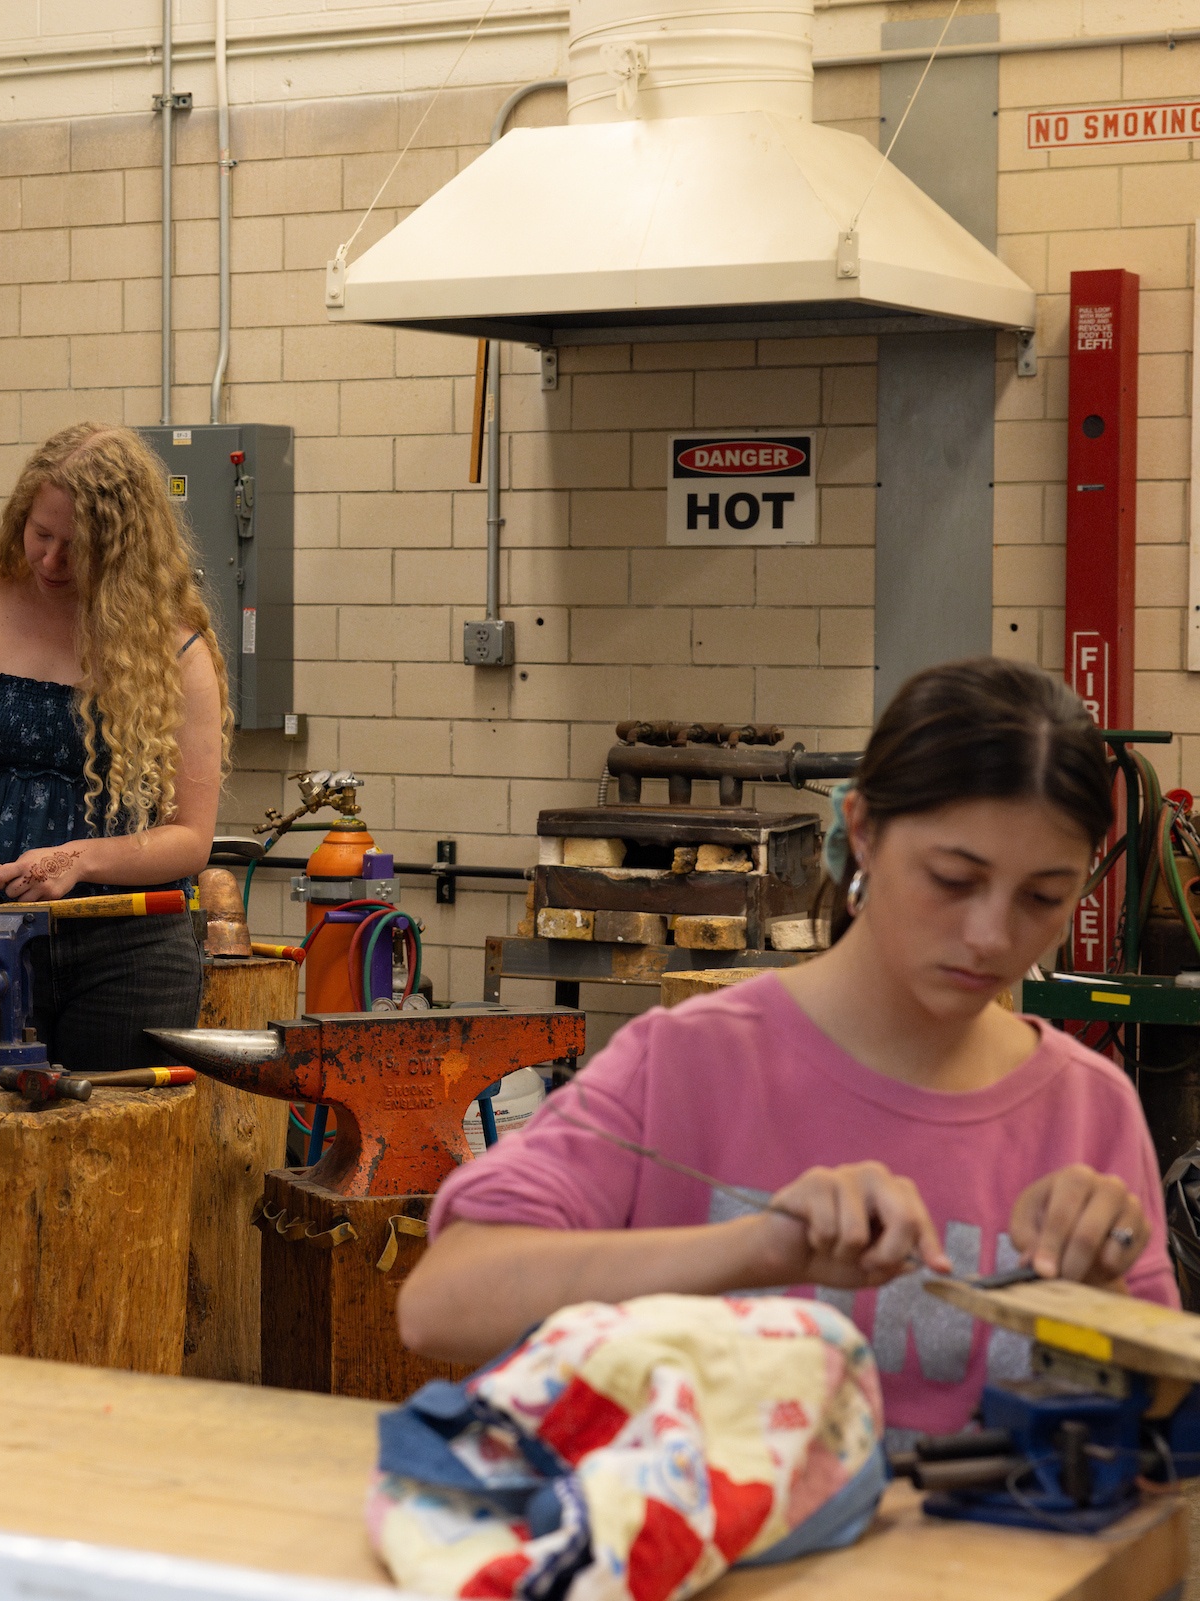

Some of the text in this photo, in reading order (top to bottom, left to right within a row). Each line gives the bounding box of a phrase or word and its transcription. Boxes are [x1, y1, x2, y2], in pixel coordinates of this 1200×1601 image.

[1035, 117, 1069, 143] NO
[1078, 324, 1112, 332] REVOLVE
[1102, 331, 1113, 339] TO
[1078, 338, 1112, 350] LEFT!
[694, 449, 789, 467] DANGER
[687, 492, 795, 530] HOT
[1080, 647, 1100, 725] FIR
[384, 1097, 436, 1110] ENGLAND
